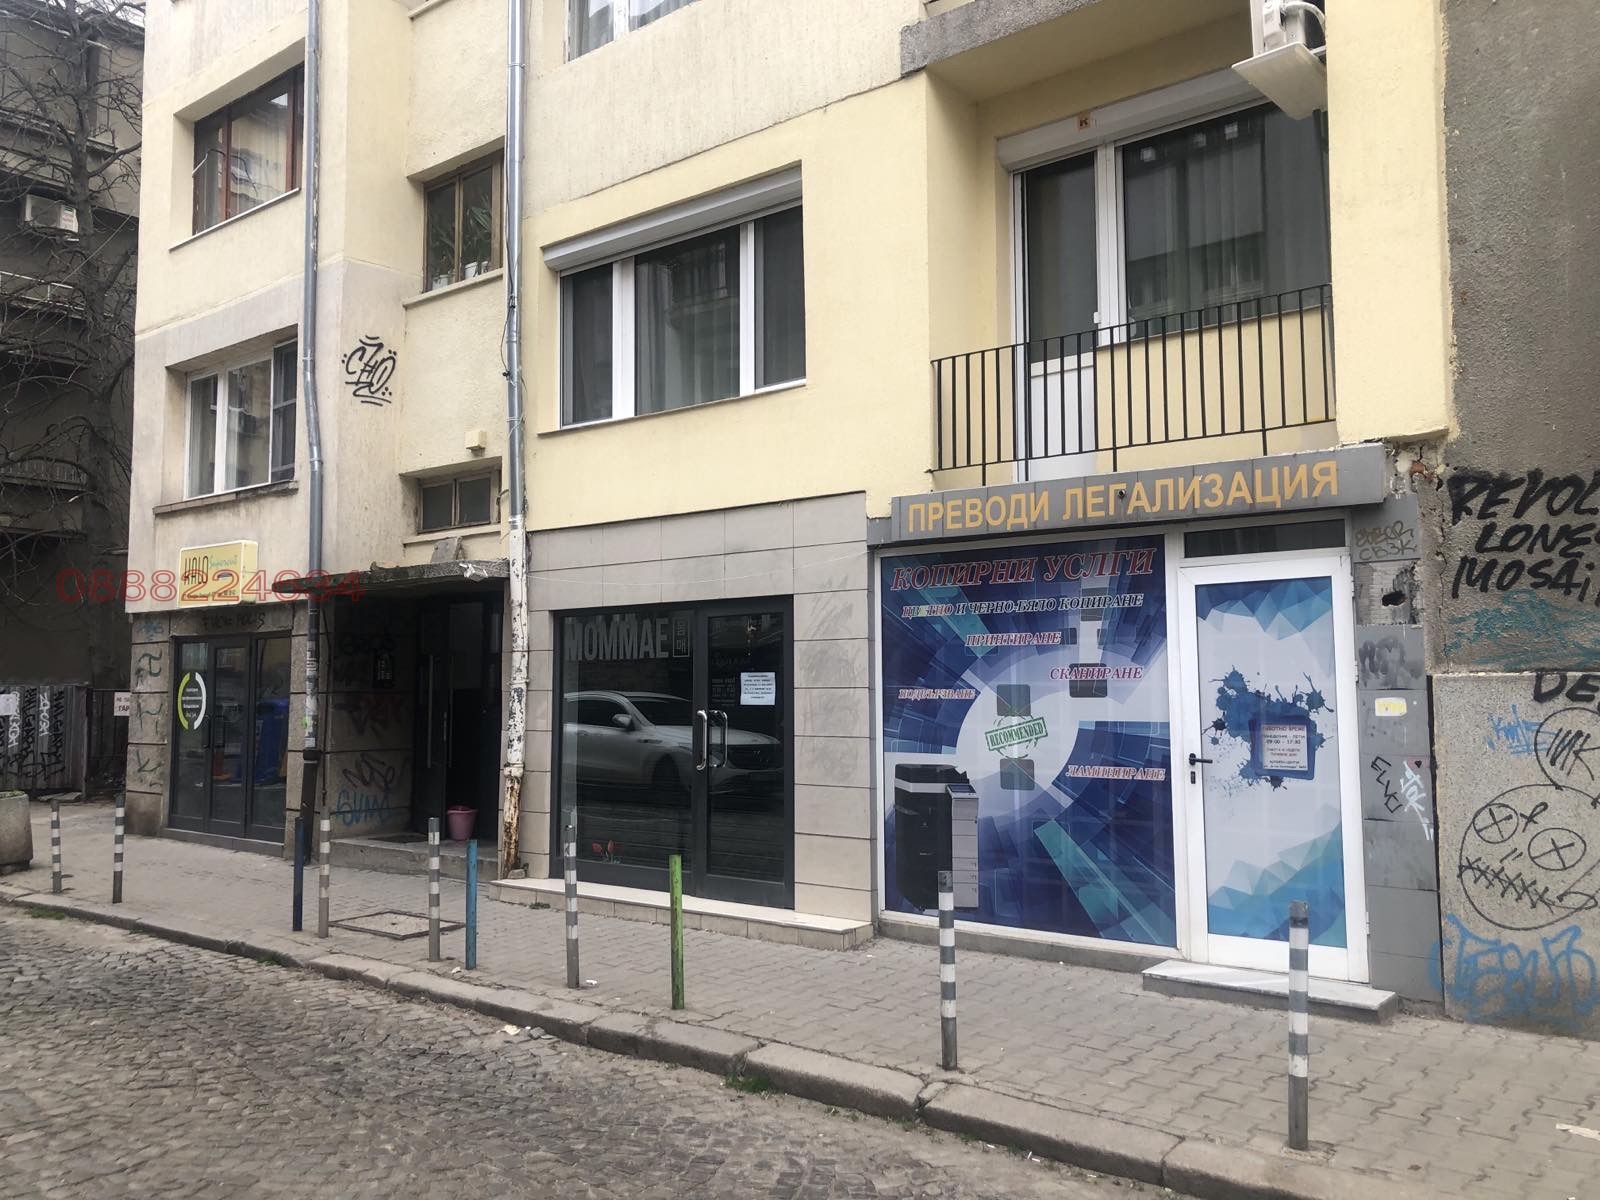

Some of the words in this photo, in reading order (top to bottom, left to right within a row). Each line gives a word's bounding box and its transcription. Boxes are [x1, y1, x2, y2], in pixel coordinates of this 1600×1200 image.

[907, 489, 1050, 532] ПРЕВОДИ
[1062, 460, 1339, 520] ЛЕГАЛИЗАЦИЯ
[890, 557, 1038, 592] КОПИРНИ
[1044, 547, 1157, 582] УСЛГИ
[954, 602, 967, 616] И
[968, 596, 1056, 616] ЧЕРНО-БЯЛО
[1058, 592, 1144, 611] КОПИРАНЕ
[964, 631, 1062, 647] ПРИНТИРАНЕ
[1049, 665, 1143, 681] СКАНИРАНЕ
[988, 722, 1045, 747] RECOMMENDED
[1065, 764, 1166, 781] ЛАМИНИРАНЕ
